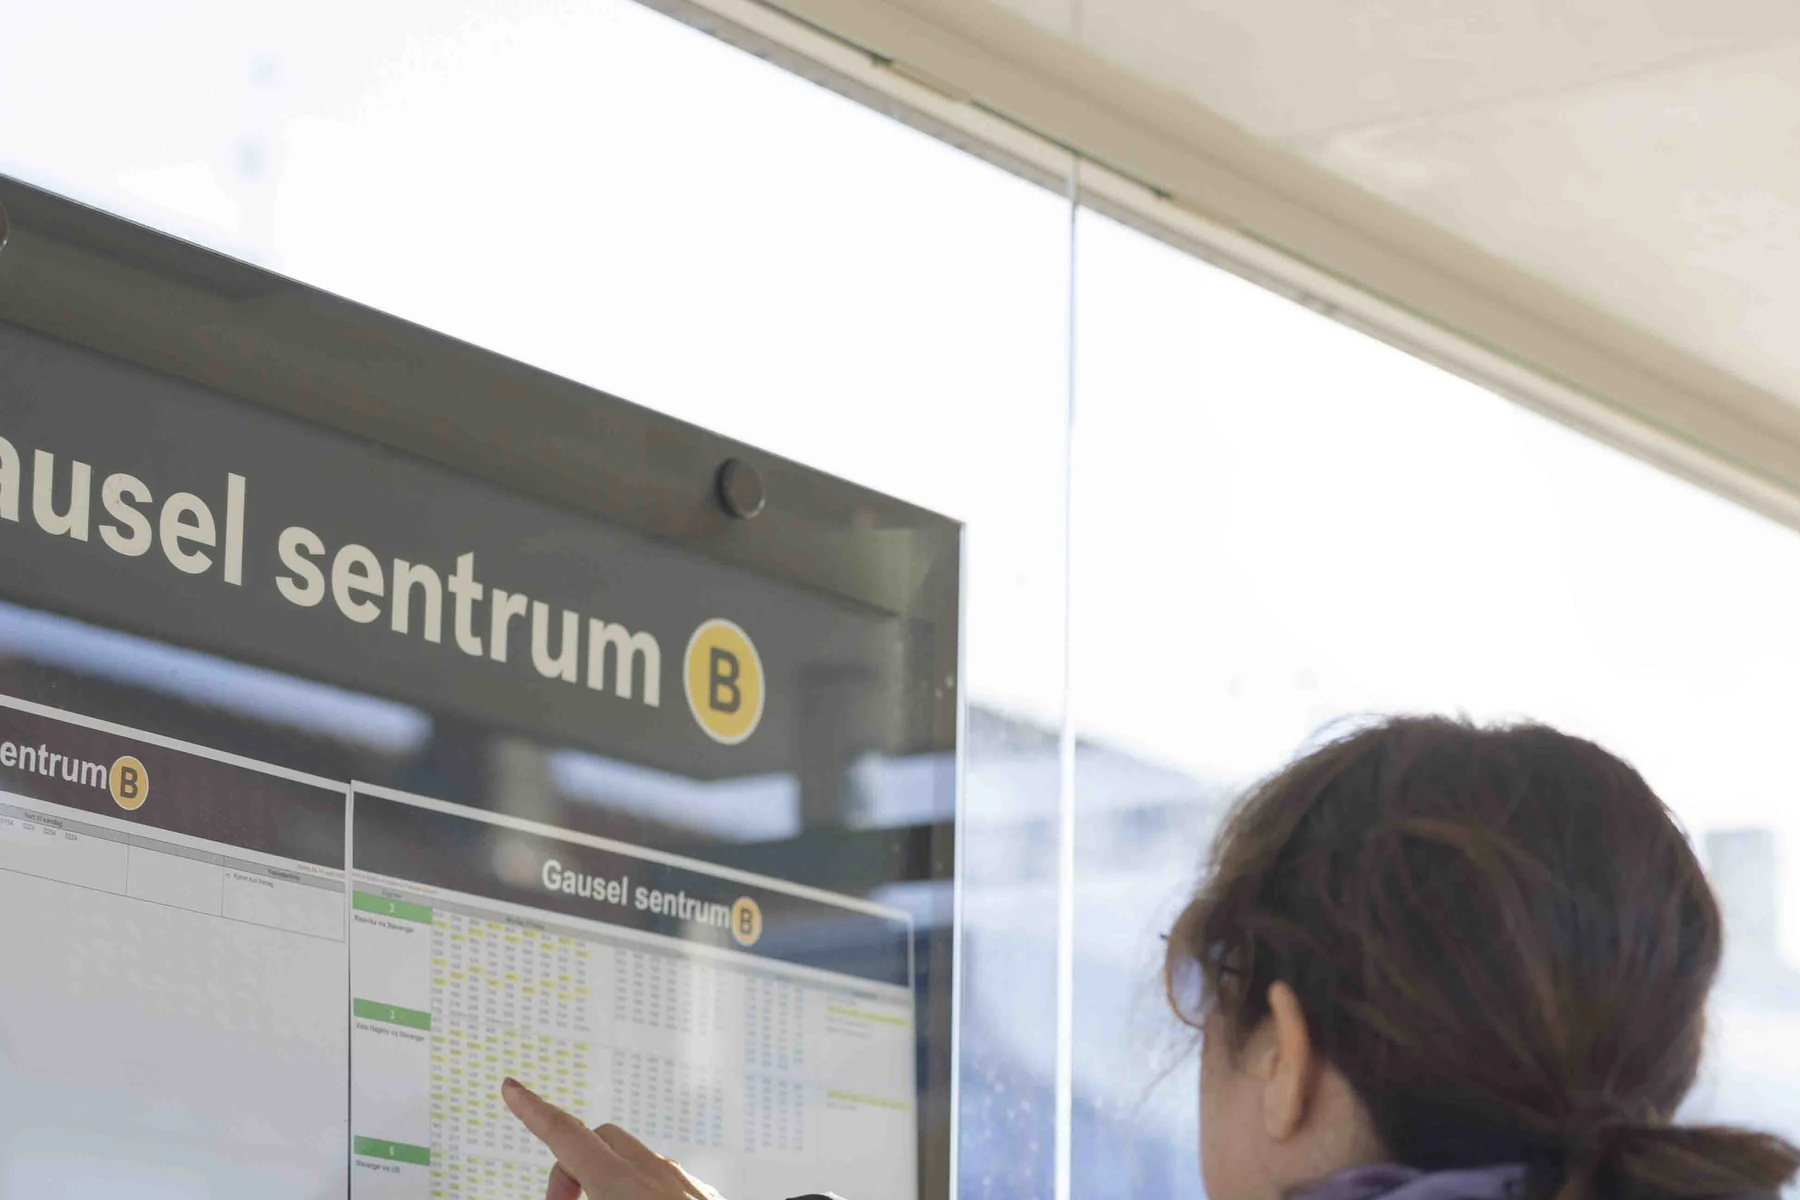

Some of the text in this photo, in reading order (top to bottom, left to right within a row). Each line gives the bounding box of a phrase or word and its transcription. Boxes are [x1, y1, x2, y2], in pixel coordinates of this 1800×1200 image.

[275, 526, 661, 707] sentrum
[708, 647, 741, 714] B
[120, 766, 138, 799] B
[389, 902, 396, 913] 2
[542, 859, 753, 934] Gausel sentrum B
